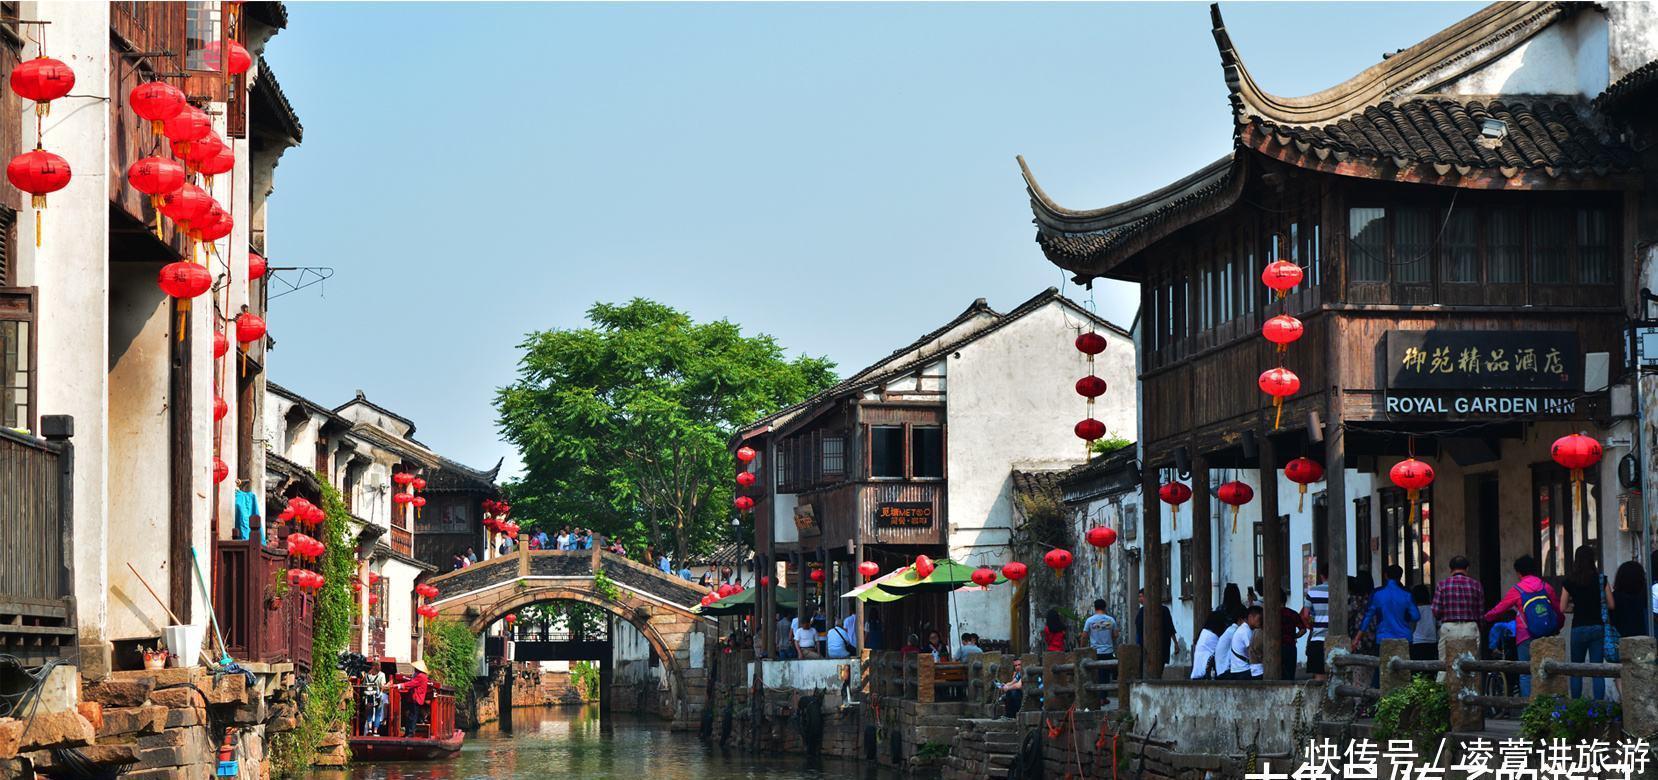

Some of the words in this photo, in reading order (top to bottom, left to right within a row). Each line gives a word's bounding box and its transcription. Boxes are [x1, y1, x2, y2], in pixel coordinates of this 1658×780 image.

[46, 68, 60, 80] 山
[41, 161, 56, 173] 山
[1402, 346, 1565, 374] 御苑精品酒店
[1386, 398, 1448, 413] ROYAL
[1455, 398, 1538, 413] GARDEN
[1544, 398, 1576, 413] INN
